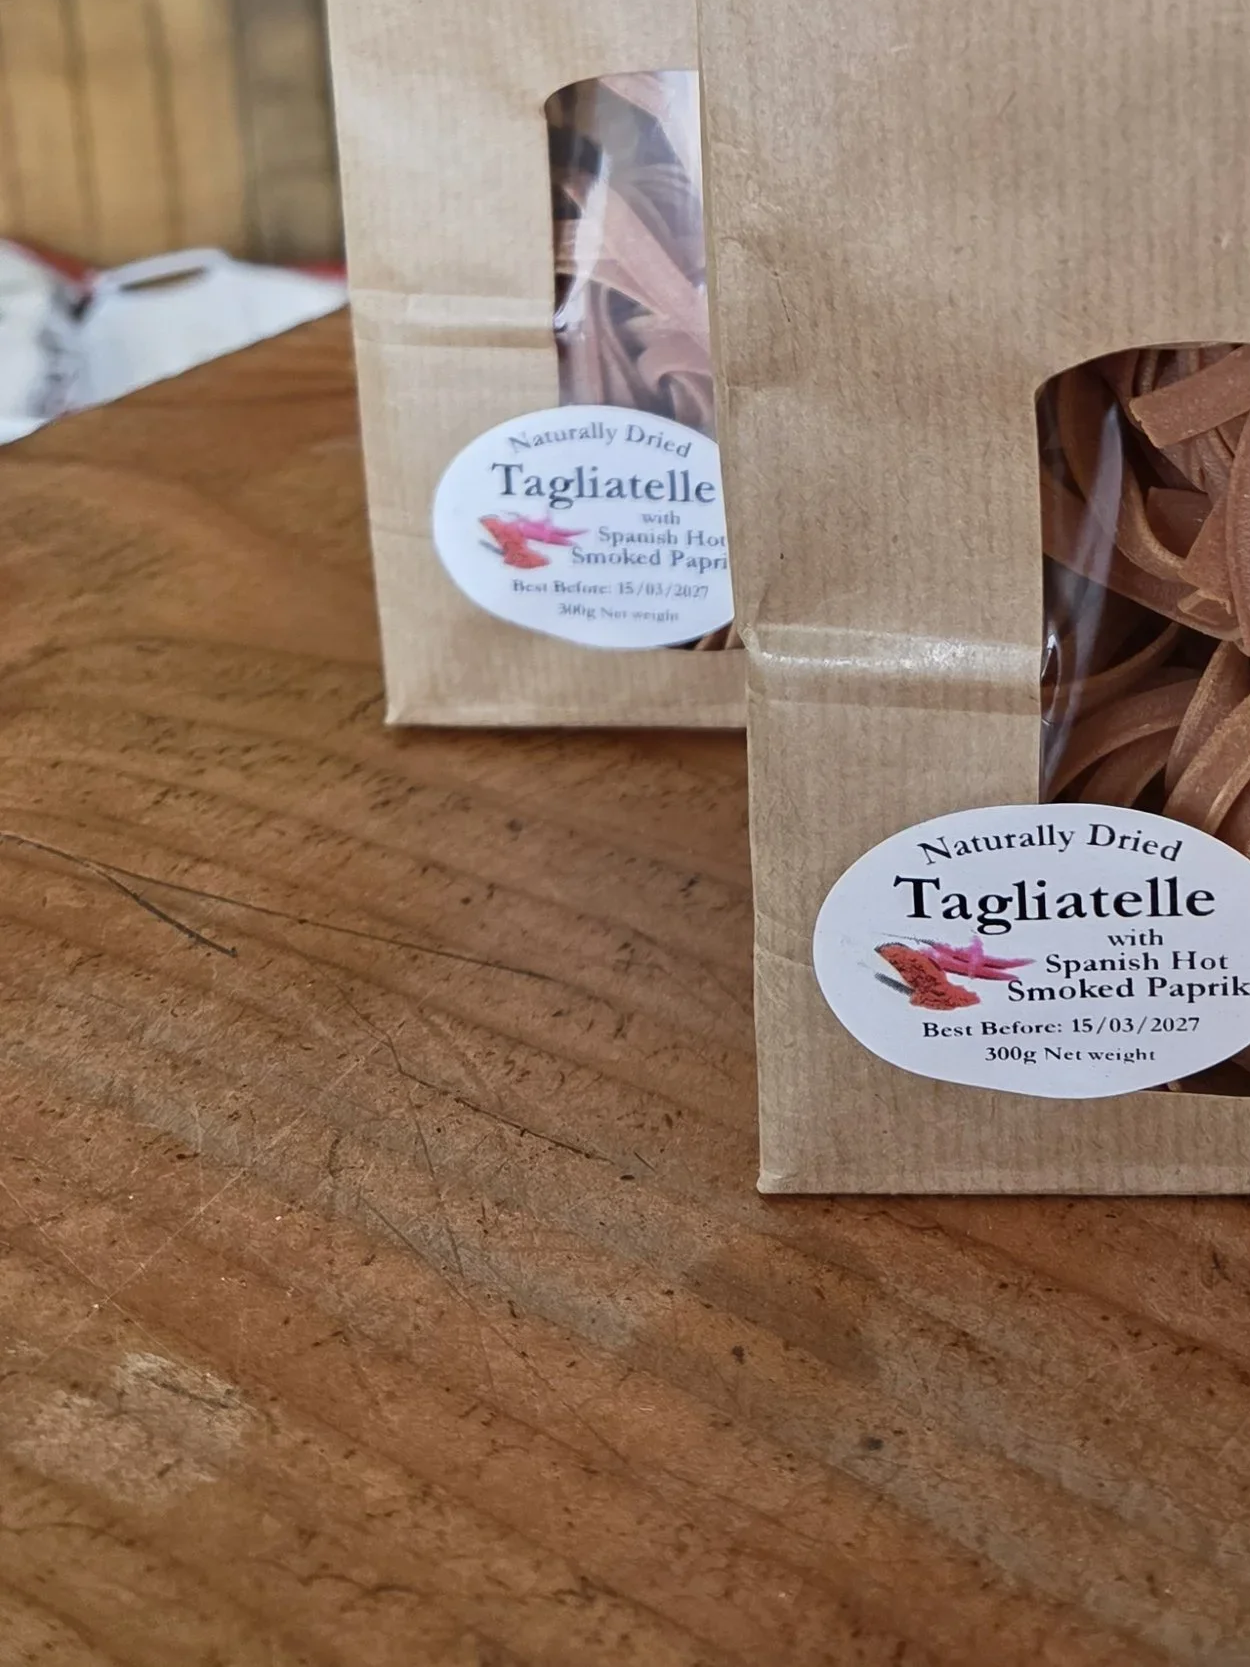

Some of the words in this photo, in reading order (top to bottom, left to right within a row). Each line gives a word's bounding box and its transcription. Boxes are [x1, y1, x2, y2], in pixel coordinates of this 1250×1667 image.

[508, 422, 618, 454] Naturally
[626, 424, 692, 459] Dried
[492, 462, 716, 510] Tagliatelle
[641, 510, 680, 525] with
[599, 526, 678, 547] Spanish
[571, 547, 660, 567] Smoked
[669, 549, 728, 574] Papri
[917, 824, 1075, 865] Naturally
[1086, 823, 1182, 862] Dried
[893, 875, 1216, 935] Tagliatelle
[1108, 929, 1164, 947] with
[1045, 953, 1159, 979] Spanish
[1171, 951, 1229, 971] Hot
[1007, 977, 1135, 1002] Smoked
[922, 1020, 972, 1037] Best
[981, 1018, 1062, 1036] Before:
[1072, 1016, 1200, 1035] 15/03/2027
[985, 1046, 1037, 1065] 300g
[1045, 1046, 1082, 1062] Net
[1089, 1047, 1156, 1064] weight
